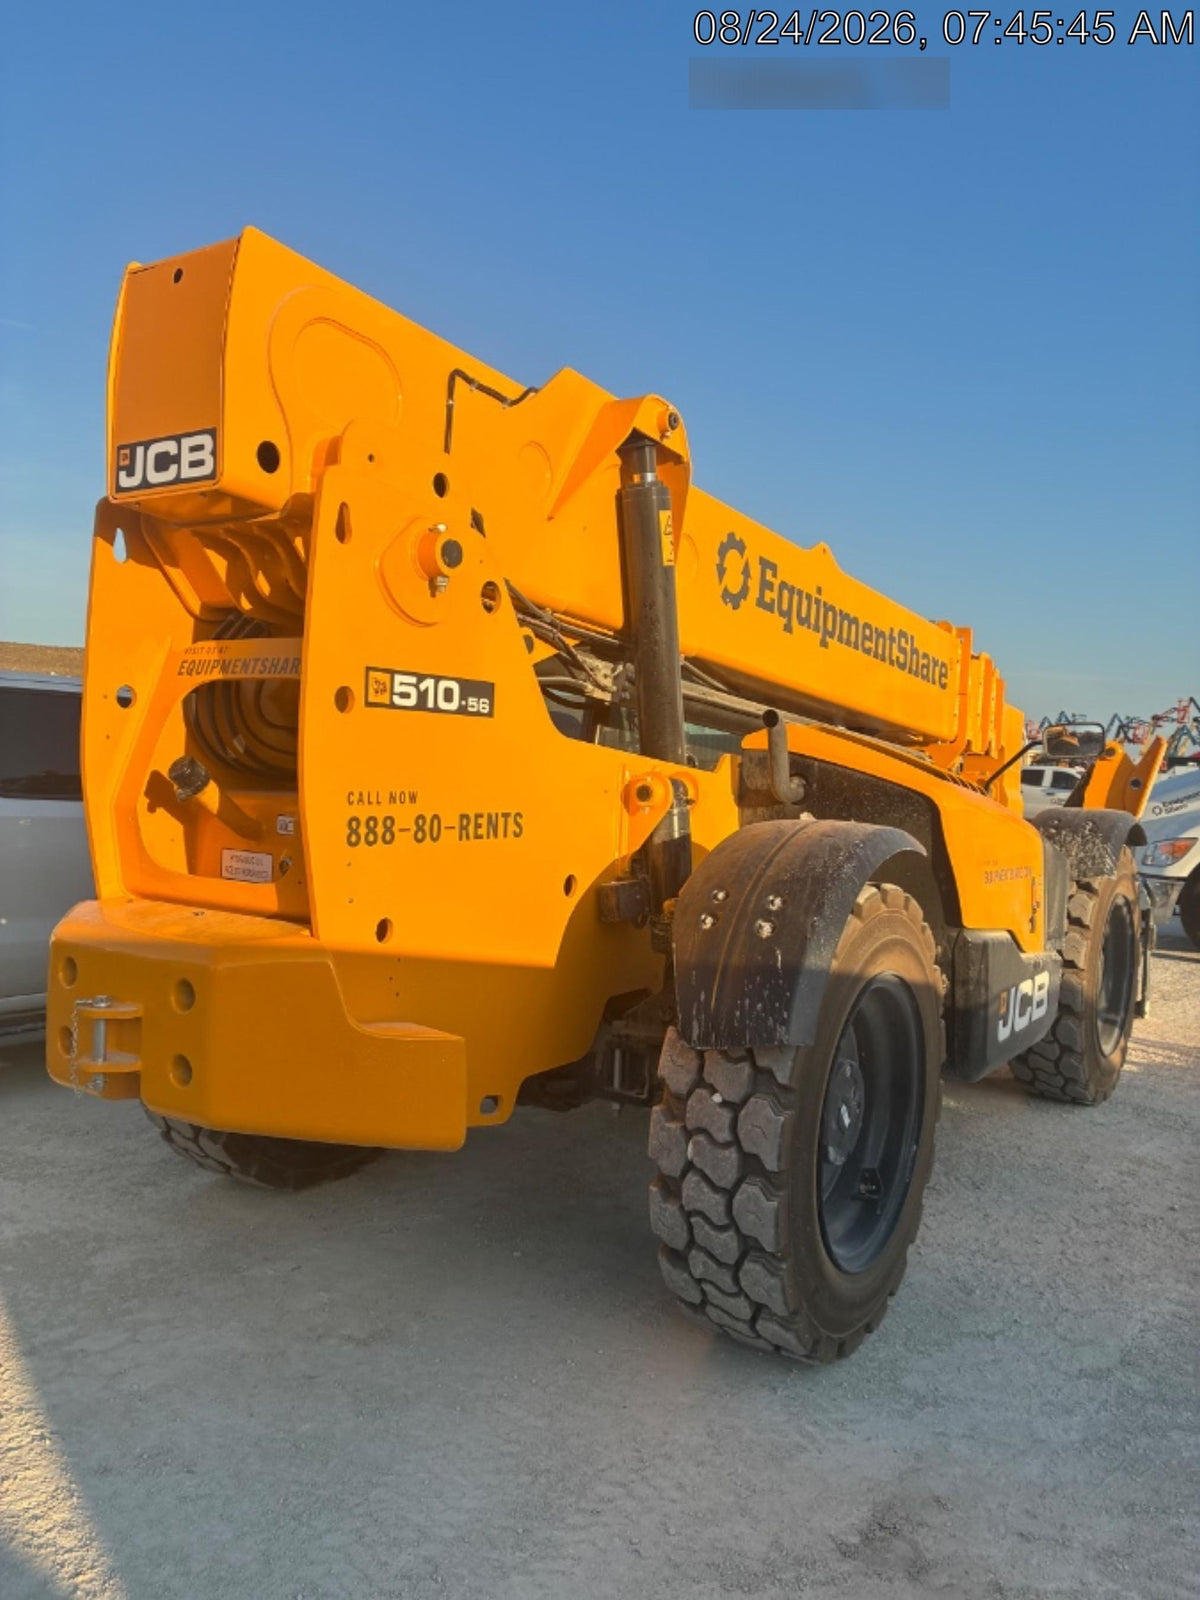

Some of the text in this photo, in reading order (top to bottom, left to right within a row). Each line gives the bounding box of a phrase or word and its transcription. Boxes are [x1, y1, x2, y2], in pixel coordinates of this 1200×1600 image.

[118, 433, 214, 488] JCB
[755, 555, 949, 690] EquipmentShare
[347, 791, 418, 806] CALL NOW
[346, 812, 523, 848] 888-80-RENTS
[997, 969, 1049, 1042] JCB
